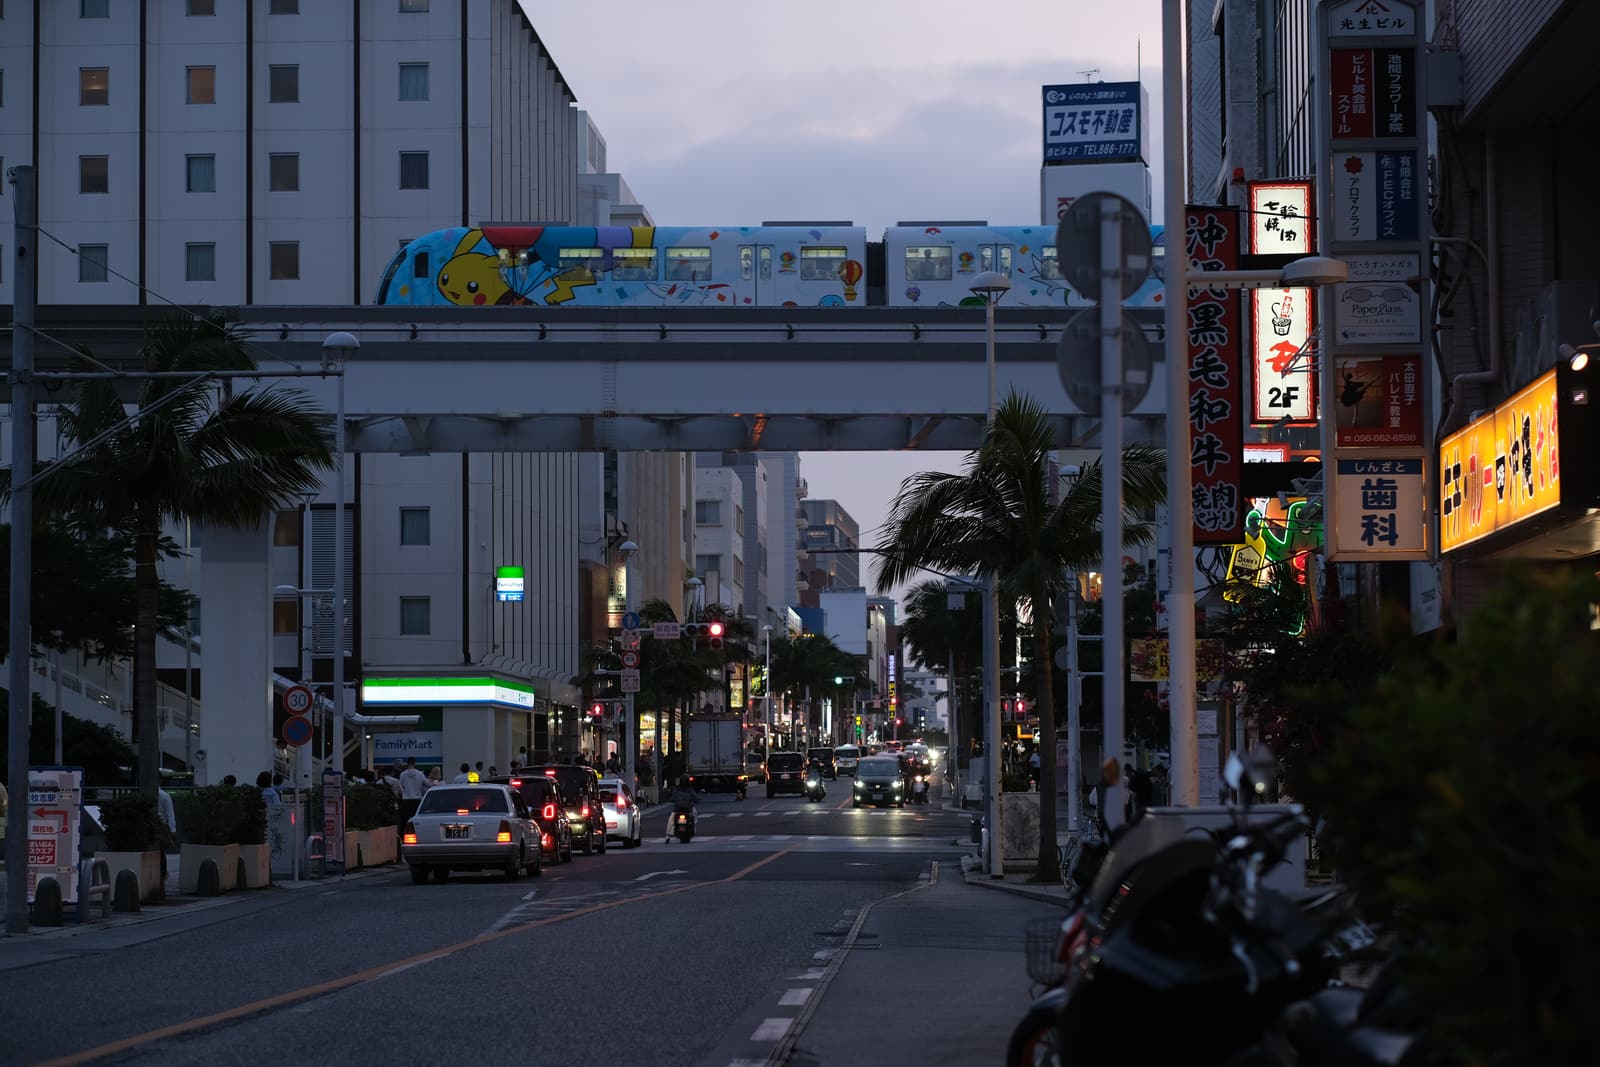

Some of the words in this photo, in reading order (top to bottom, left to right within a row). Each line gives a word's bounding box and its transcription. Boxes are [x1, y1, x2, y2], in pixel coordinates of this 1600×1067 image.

[1341, 18, 1406, 30] 光生ビル
[1351, 55, 1367, 114] ビルト英会話
[1050, 108, 1134, 137] コスモ不動産
[1338, 94, 1351, 134] スクール
[1263, 201, 1298, 220] 七輪
[1349, 177, 1361, 237] アロマクラブ
[1264, 217, 1297, 241] 焼肉
[1268, 386, 1299, 408] 2F
[1389, 372, 1401, 428] バレエ教室
[1355, 461, 1405, 473] しんざと
[1361, 478, 1399, 546] 歯科
[290, 694, 307, 707] 30
[375, 739, 433, 752] FamilyMart
[28, 856, 54, 865] ロピア
